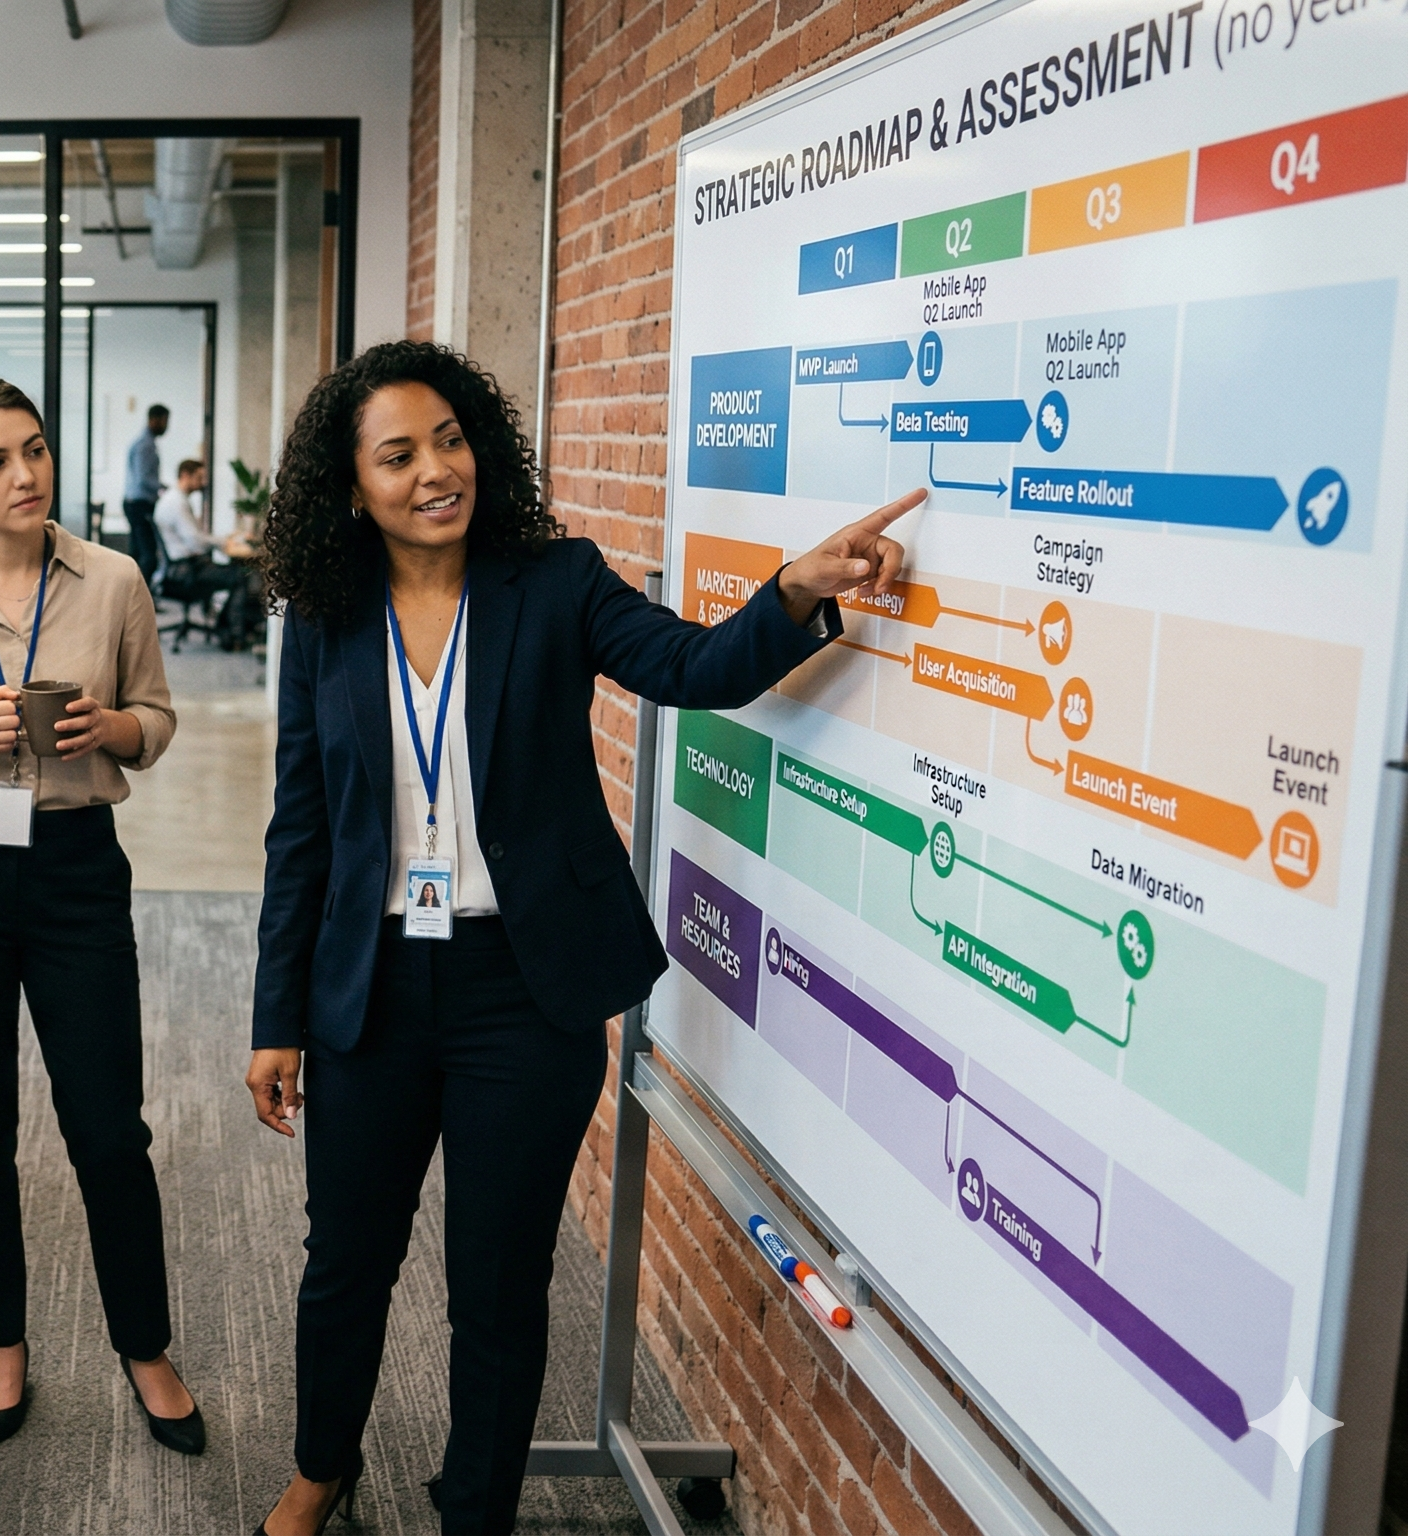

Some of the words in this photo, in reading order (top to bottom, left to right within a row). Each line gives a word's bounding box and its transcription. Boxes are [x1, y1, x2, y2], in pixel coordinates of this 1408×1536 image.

[695, 153, 795, 226] STRATEGIC
[800, 107, 922, 194] ROADMAP
[930, 97, 949, 152] &
[956, 2, 1203, 144] ASSESSMENT
[1215, 0, 1273, 71] (no
[1270, 133, 1320, 195] Q4
[1085, 182, 1122, 231] Q3
[945, 217, 973, 258] Q2
[834, 245, 854, 279] Q1
[923, 275, 961, 300] Mobile
[963, 273, 987, 298] App
[923, 303, 939, 326] Q2
[941, 296, 983, 321] Launch
[1045, 329, 1093, 353] Mobile
[1097, 328, 1126, 354] App
[799, 357, 822, 377] MVP
[823, 352, 858, 375] Launch
[1045, 360, 1065, 383] Q2
[1068, 355, 1120, 381] Launch
[709, 389, 763, 415] PRODUCT
[696, 423, 777, 448] DEVELOPMENT
[924, 410, 969, 438] Testing
[1019, 477, 1074, 503] Feature
[1077, 479, 1134, 508] Rollout
[1034, 534, 1103, 566] Campaign
[1037, 561, 1094, 594] Strategy
[698, 599, 706, 622] &
[918, 653, 945, 680] User
[946, 661, 1016, 702] Acquisition
[686, 745, 755, 800] TECHNOLOGY
[1267, 735, 1340, 775] Launch
[783, 761, 839, 804] Infrastructure
[840, 788, 867, 822] Setup
[913, 752, 986, 799] Infrastructure
[1072, 763, 1127, 804] Launch
[1130, 784, 1178, 822] Event
[1272, 769, 1328, 806] Event
[931, 784, 963, 818] Setup
[1091, 848, 1124, 881] Data
[1128, 863, 1204, 914] Migration
[693, 891, 721, 933] TEAM
[722, 915, 730, 940] &
[681, 914, 741, 979] RESOURCES
[783, 949, 810, 989] Hiring
[947, 934, 969, 962] API
[971, 944, 1036, 1004] Integration
[991, 1197, 1042, 1262] Training
